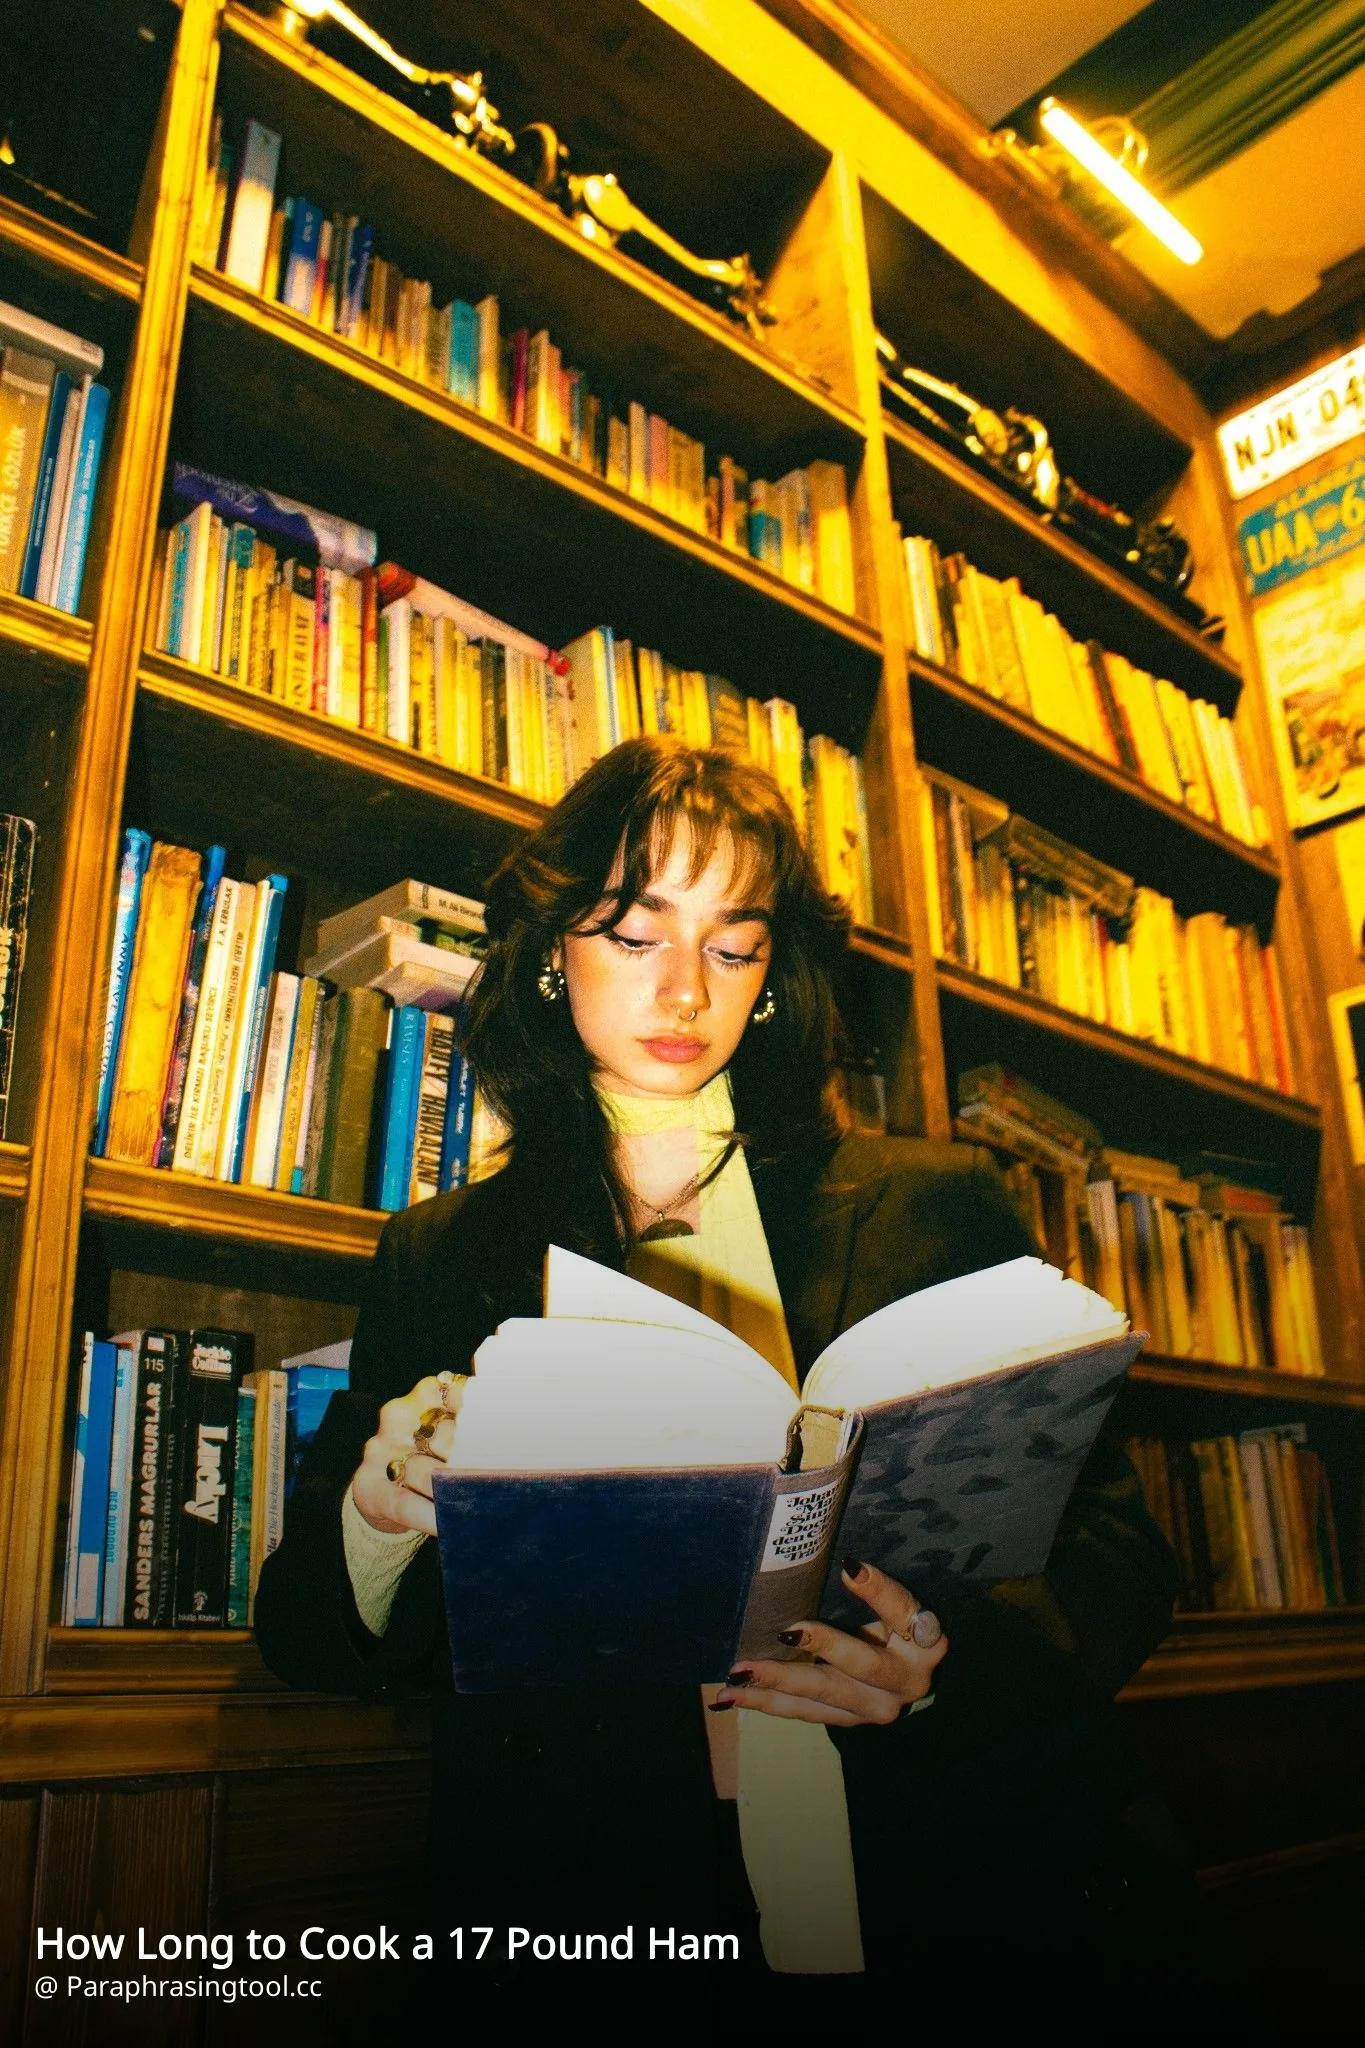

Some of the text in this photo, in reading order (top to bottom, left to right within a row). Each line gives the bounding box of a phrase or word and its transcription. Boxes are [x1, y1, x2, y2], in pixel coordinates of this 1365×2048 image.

[144, 1357, 165, 1373] 115
[191, 1356, 232, 1374] Collins
[183, 1423, 229, 1524] Lucky
[772, 1536, 805, 1546] den
[133, 1518, 155, 1622] SANDERS
